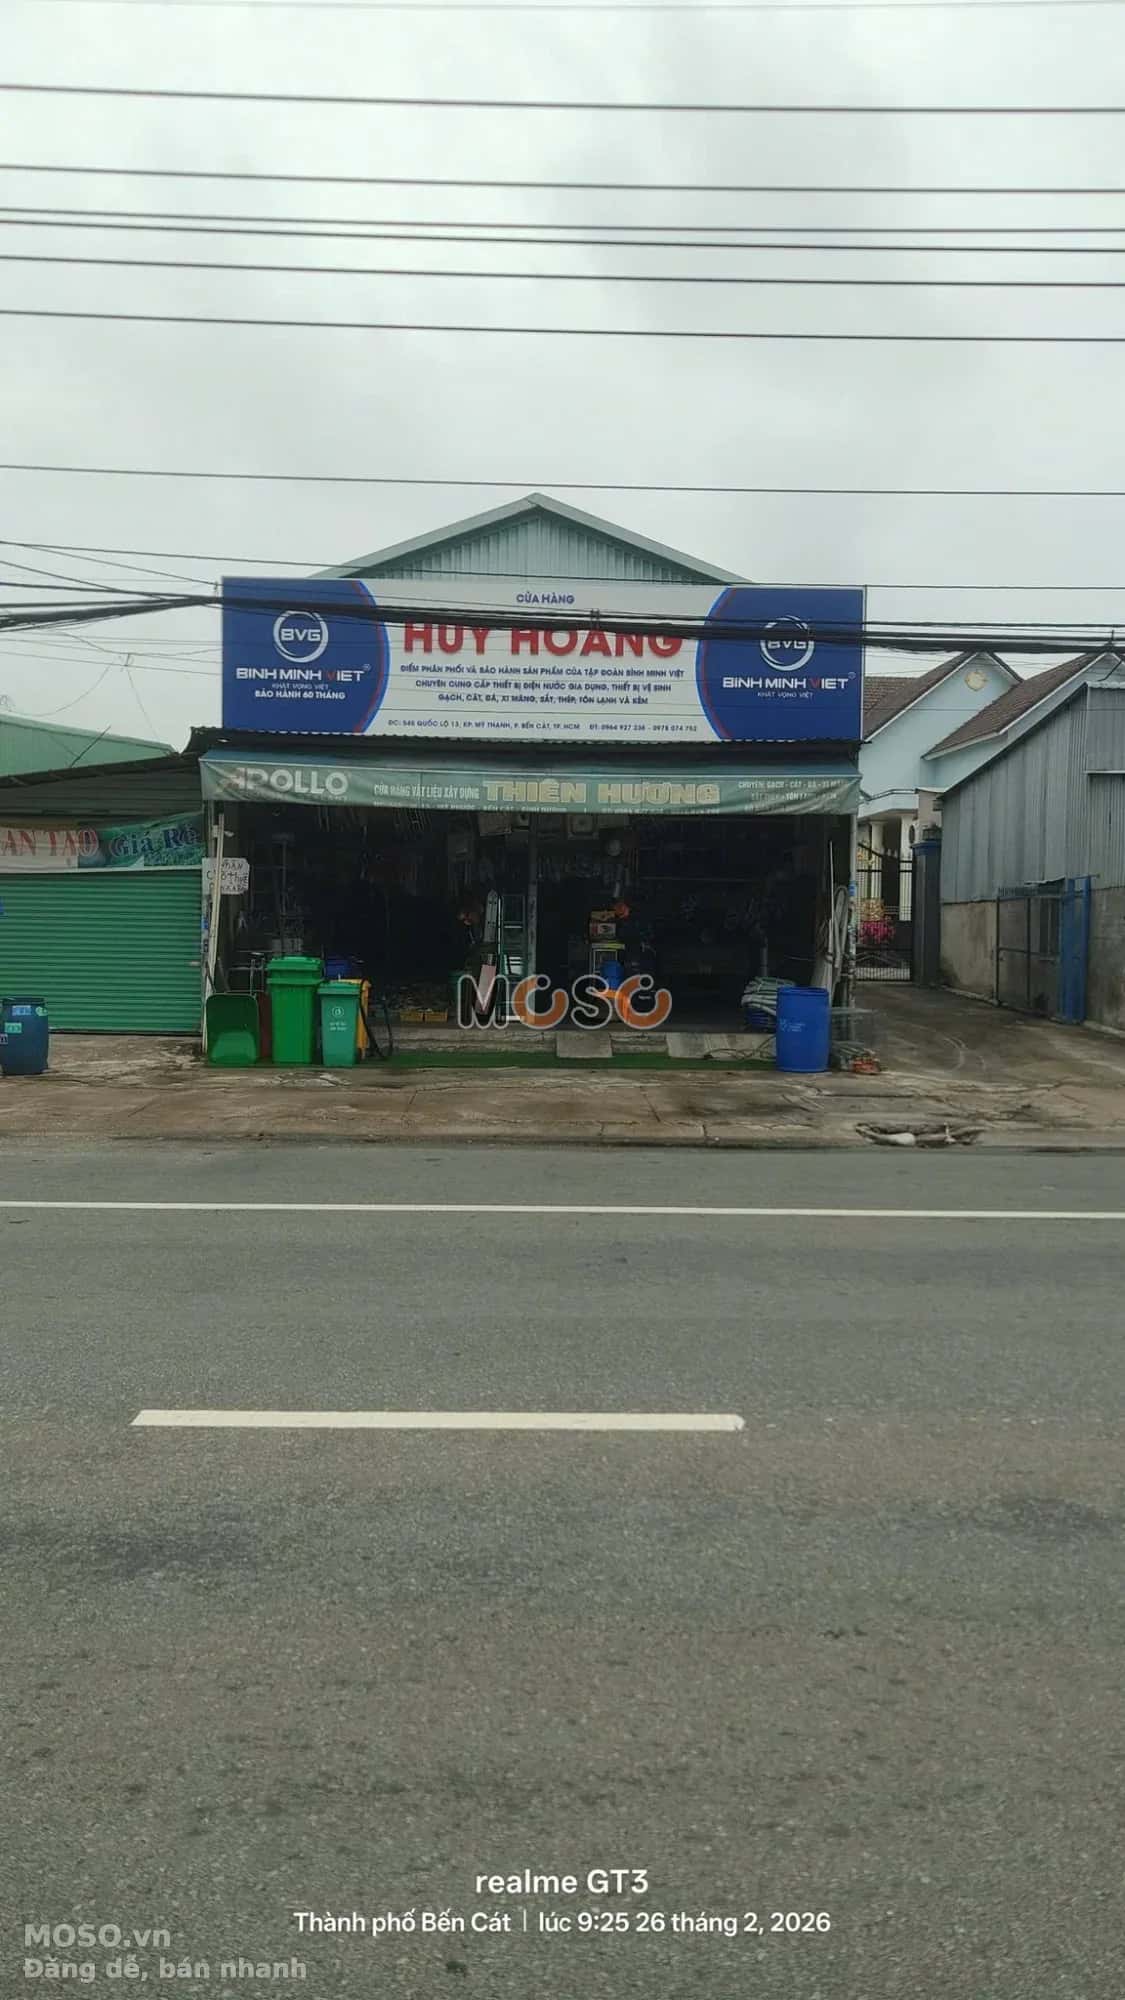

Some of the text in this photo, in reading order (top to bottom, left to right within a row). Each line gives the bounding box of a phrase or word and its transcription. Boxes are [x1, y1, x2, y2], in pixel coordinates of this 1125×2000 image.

[516, 590, 575, 604] CỬA HÀNG
[280, 628, 321, 641] BVG
[403, 617, 493, 656] HUY
[767, 639, 807, 649] BVG
[235, 667, 365, 682] BINH MINH VIET
[448, 680, 472, 689] CUNG
[568, 682, 583, 690] GIA
[722, 676, 849, 690] BINH MINH VIET
[255, 687, 346, 700] BẢO HÀNH 60 THÁNG
[482, 779, 587, 803] THIÊN
